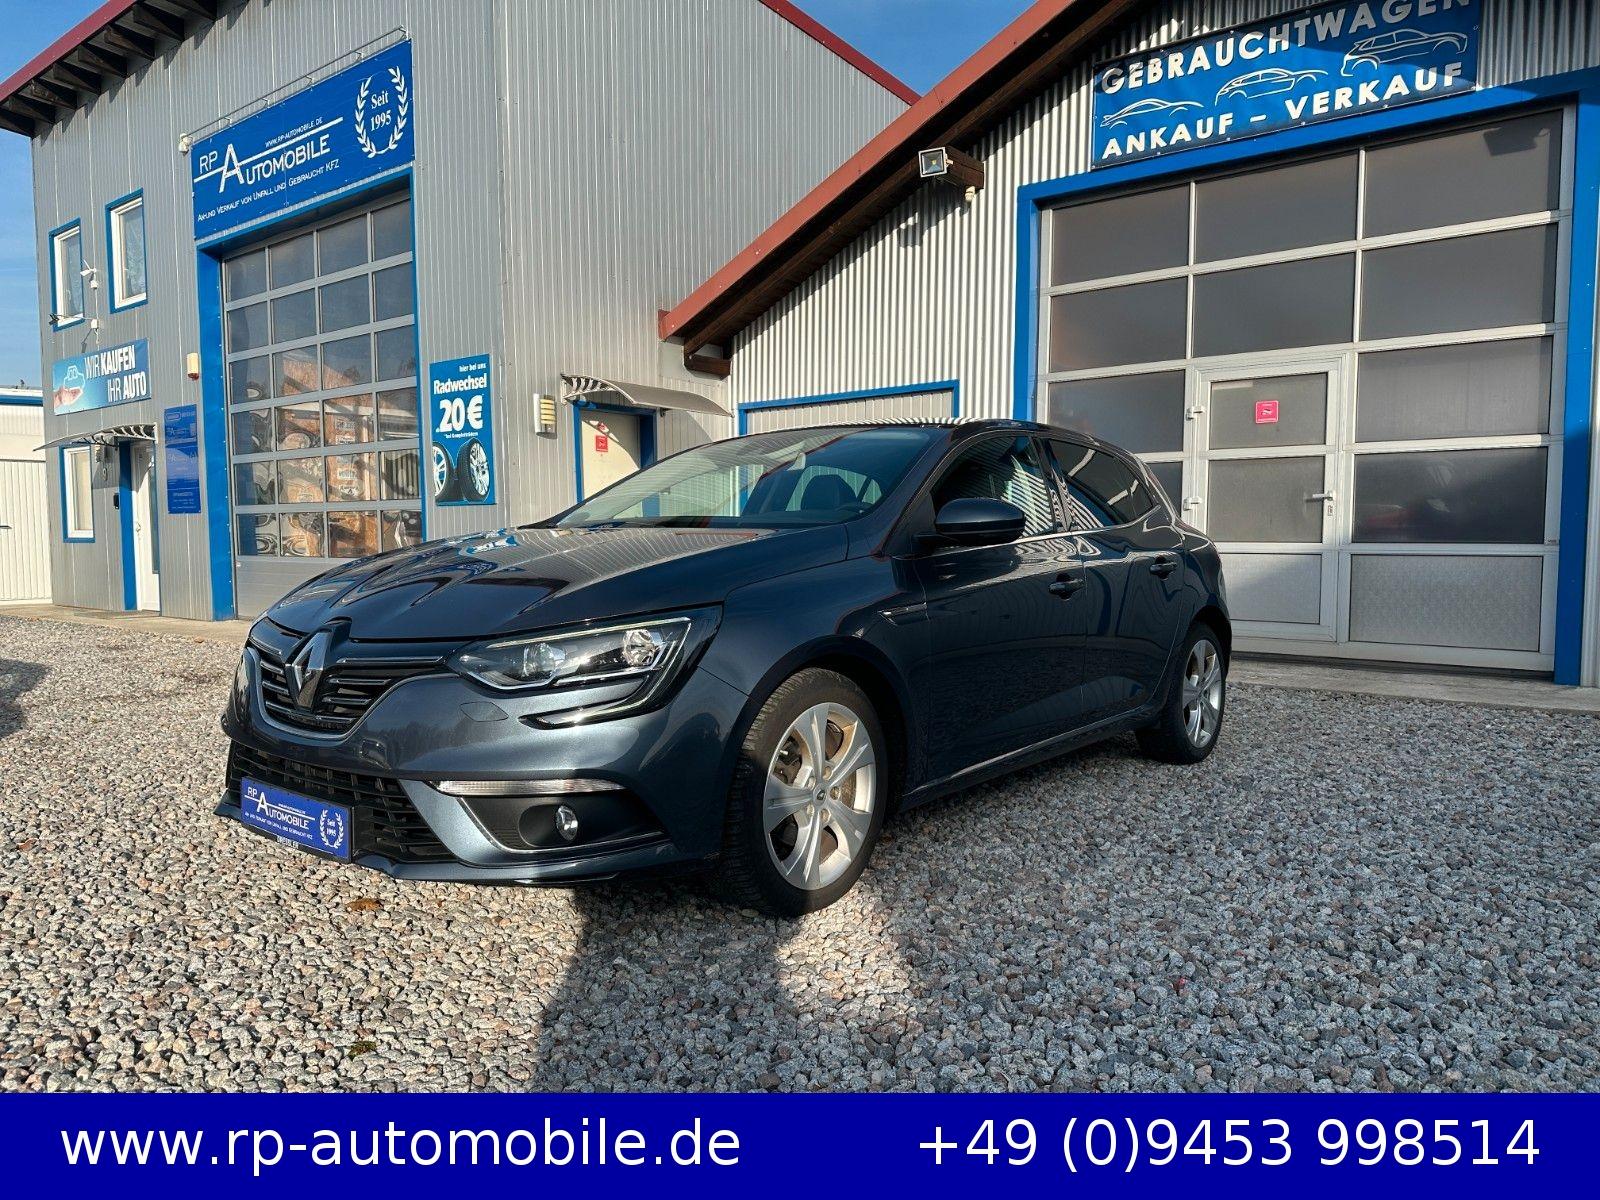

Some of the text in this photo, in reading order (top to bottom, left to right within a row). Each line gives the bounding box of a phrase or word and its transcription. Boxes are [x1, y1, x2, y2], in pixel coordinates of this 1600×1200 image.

[371, 91, 389, 110] Seit
[1102, 112, 1234, 160] ANKAUF
[1284, 61, 1463, 121] VERKAUF
[370, 110, 392, 132] 1995
[199, 150, 218, 174] RP
[216, 200, 240, 215] VERKAUF
[241, 195, 252, 205] VON
[288, 166, 324, 187] GEBRAUCHT
[325, 159, 340, 172] KFZ
[84, 344, 135, 379] WIR KAUFEN
[107, 371, 147, 402] IHR AUTO
[433, 372, 487, 395] Radwechsel
[247, 786, 258, 798] RP
